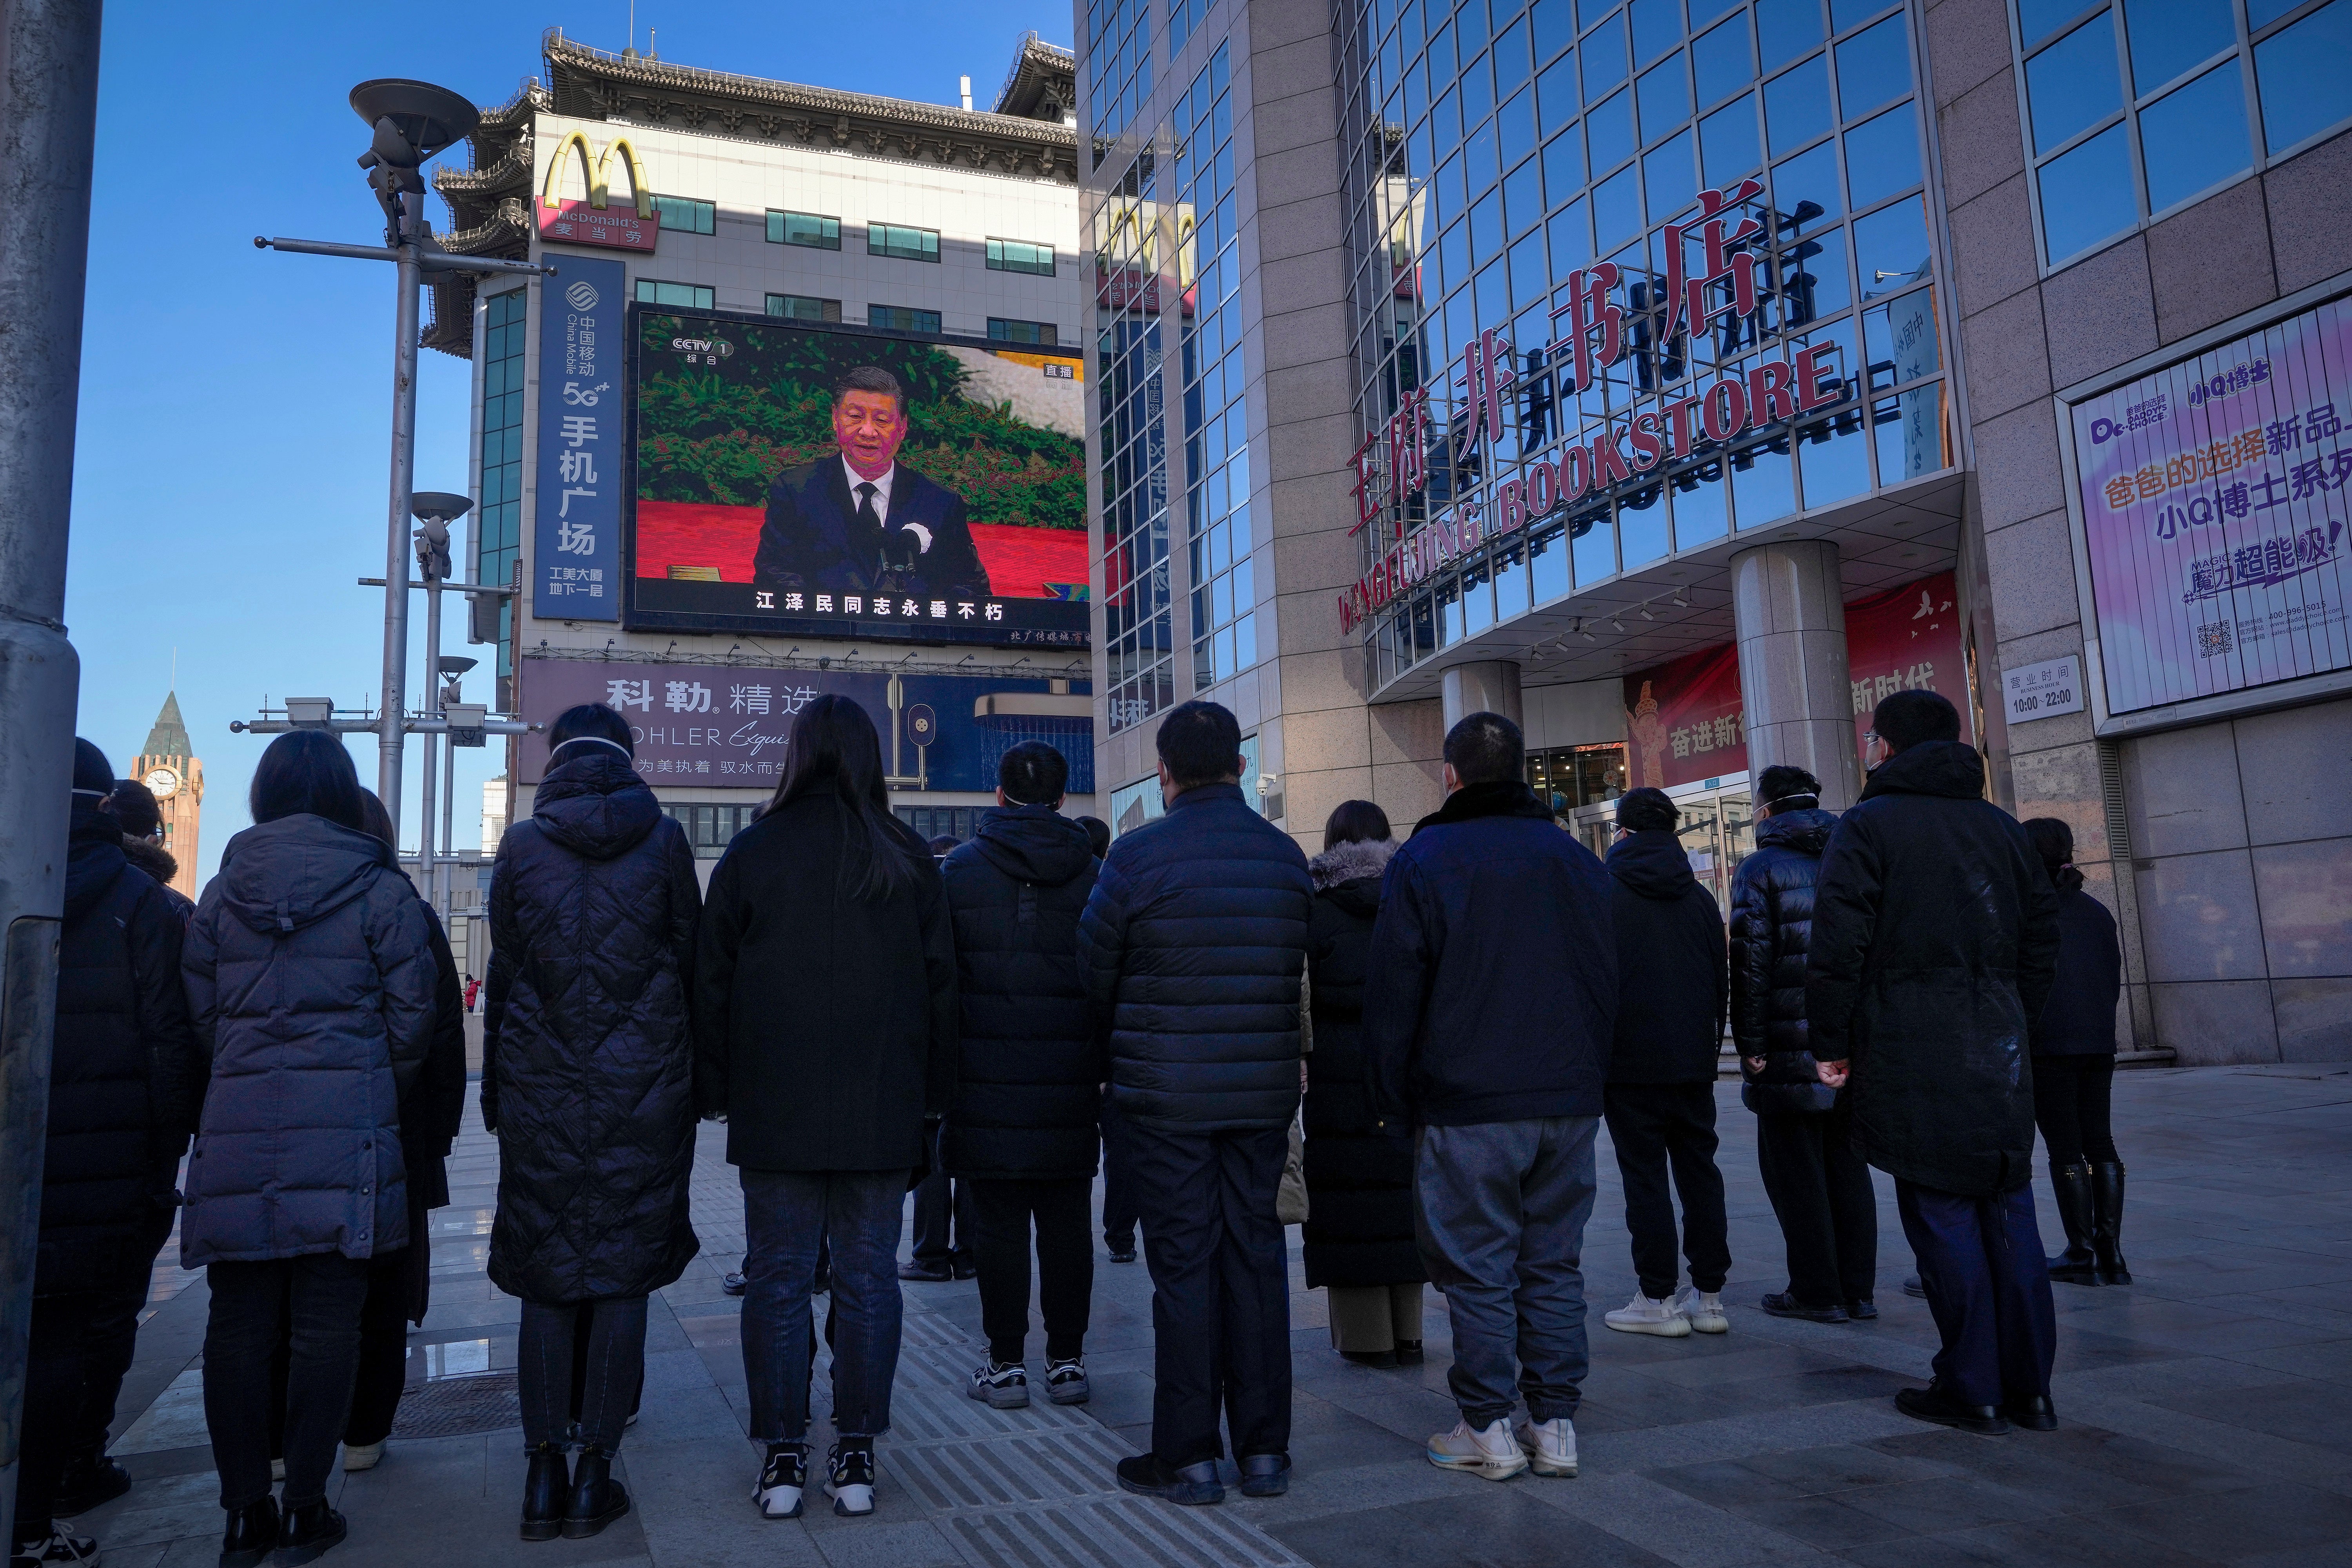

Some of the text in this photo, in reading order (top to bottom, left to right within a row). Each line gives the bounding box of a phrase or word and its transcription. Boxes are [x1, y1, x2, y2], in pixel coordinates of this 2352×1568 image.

[557, 210, 639, 229] McDonald's
[555, 222, 642, 244] 麦当劳
[566, 314, 577, 375] China Mobile
[579, 316, 595, 377] 中国移动
[672, 338, 712, 352] CCTV
[687, 354, 717, 365] 综合
[1346, 178, 1763, 537] 王府井书店
[1045, 365, 1072, 378] 直播
[1045, 377, 1073, 390] 高清
[2189, 360, 2270, 406] 小Q博士
[2126, 394, 2167, 417] 爸爸的选择
[2127, 404, 2167, 425] DADDY'S
[2129, 412, 2164, 432] CHOICE
[2105, 403, 2352, 510] 爸爸的选择新品
[557, 415, 599, 556] 手机广场
[1338, 502, 1481, 637] WANGFUJING
[1499, 339, 1842, 535] BOOKSTORE
[2191, 552, 2232, 571] MAGIC
[549, 567, 603, 582] 工美大厦
[549, 583, 603, 597] 地下一层
[756, 591, 1002, 621] 江泽民同志永垂不朽
[2010, 665, 2069, 689] 营业时间
[607, 679, 818, 715] 科勒 精选
[1852, 661, 1936, 716] 新时代
[2020, 684, 2044, 694] BUSINESS
[629, 726, 722, 746] OHLER
[637, 759, 711, 774] 为美执着
